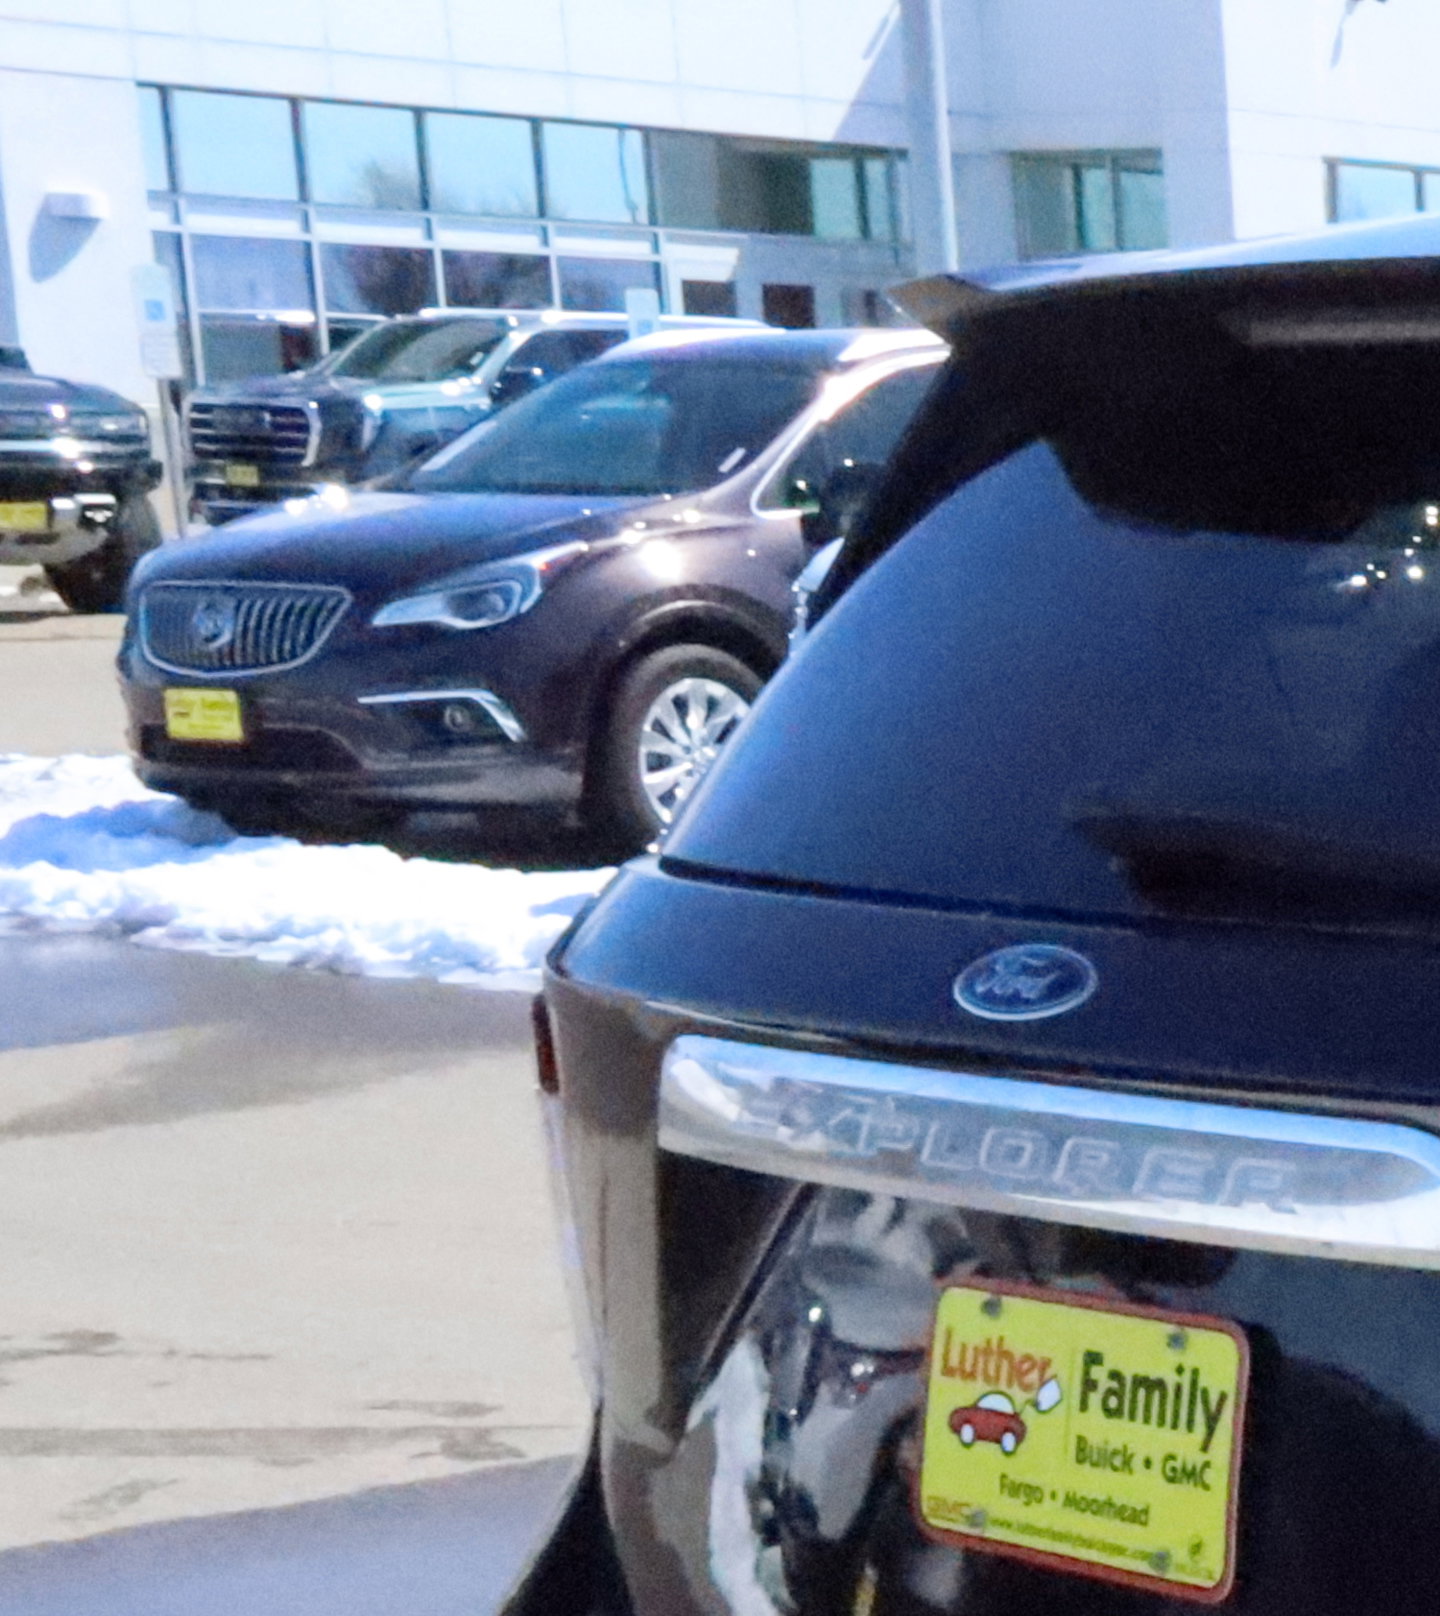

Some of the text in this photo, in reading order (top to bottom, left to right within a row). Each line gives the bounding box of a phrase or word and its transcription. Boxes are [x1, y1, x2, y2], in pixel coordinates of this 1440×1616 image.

[738, 1076, 1298, 1213] EXPLORER
[941, 1325, 1053, 1392] Luther
[1079, 1350, 1228, 1453] Family
[1075, 1434, 1212, 1490] Buick GMC
[1000, 1473, 1150, 1528] Fargo Moorhead
